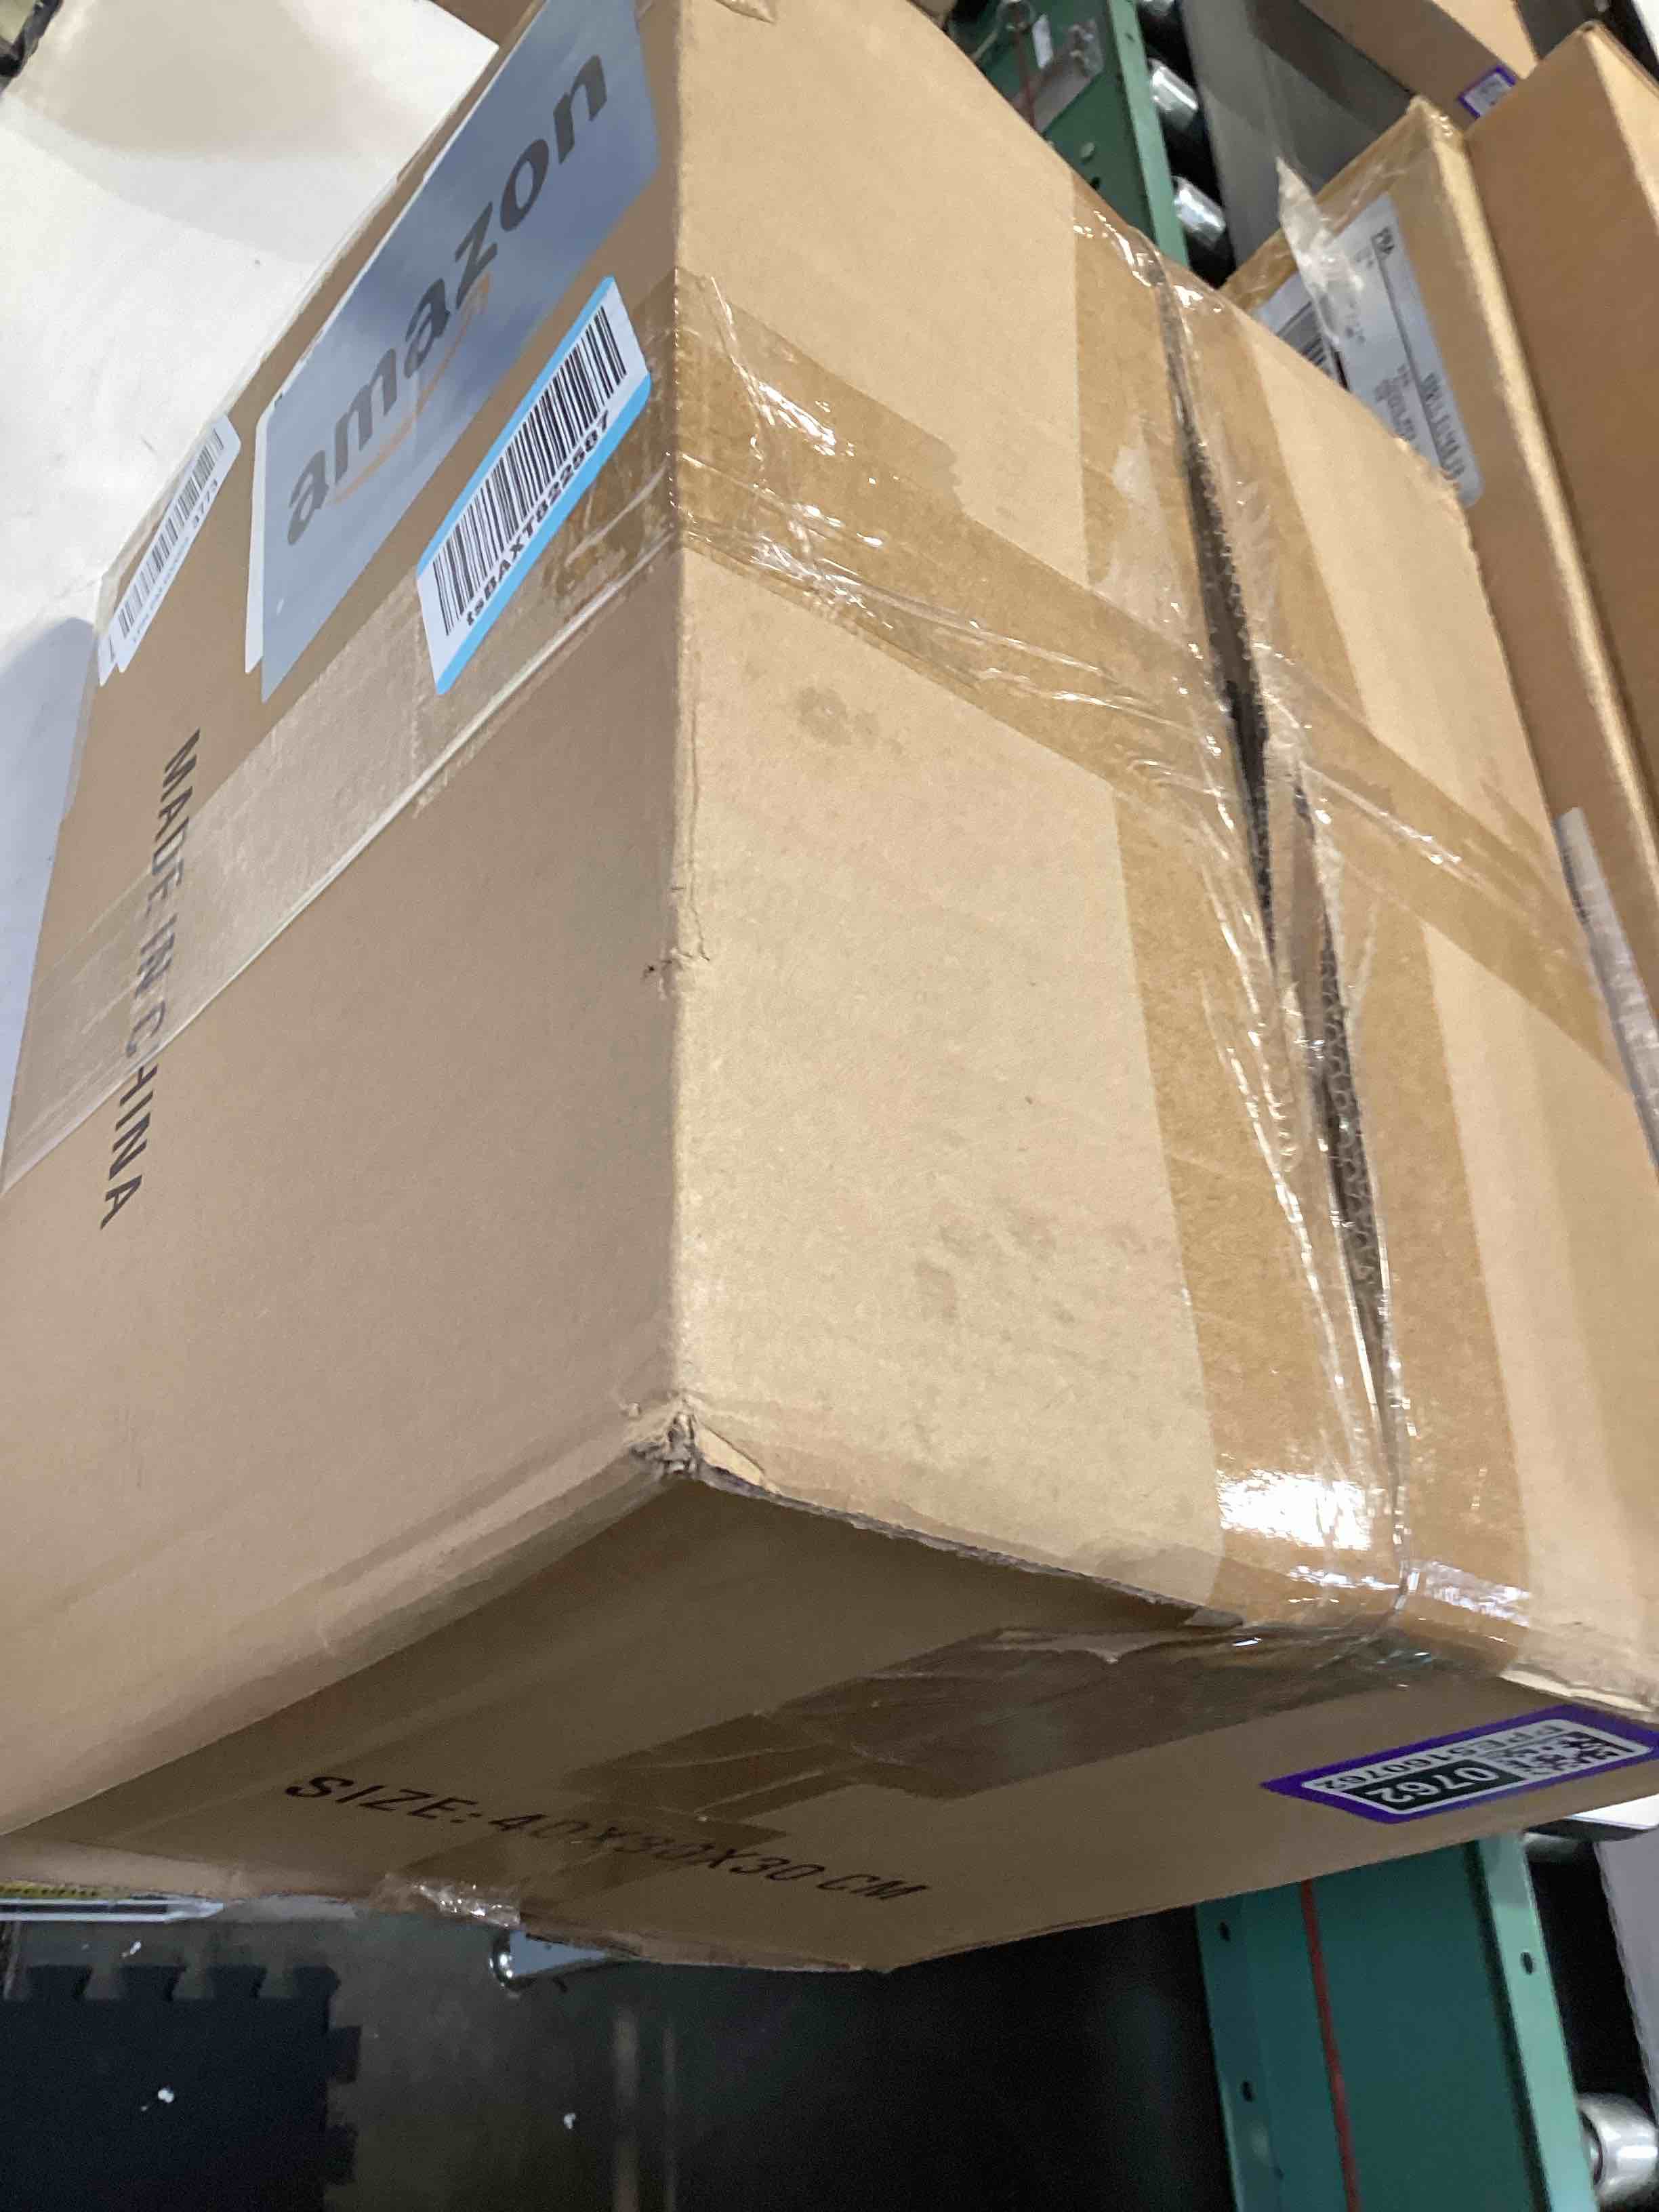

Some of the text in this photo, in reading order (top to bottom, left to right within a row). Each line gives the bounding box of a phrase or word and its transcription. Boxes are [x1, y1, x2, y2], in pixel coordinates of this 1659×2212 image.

[287, 54, 607, 546] amazon
[100, 727, 201, 1231] MADE IN CHINA
[285, 1776, 483, 1824] SIZE:
[817, 1873, 928, 1900] CM
[1366, 1767, 1500, 1803] 0762
